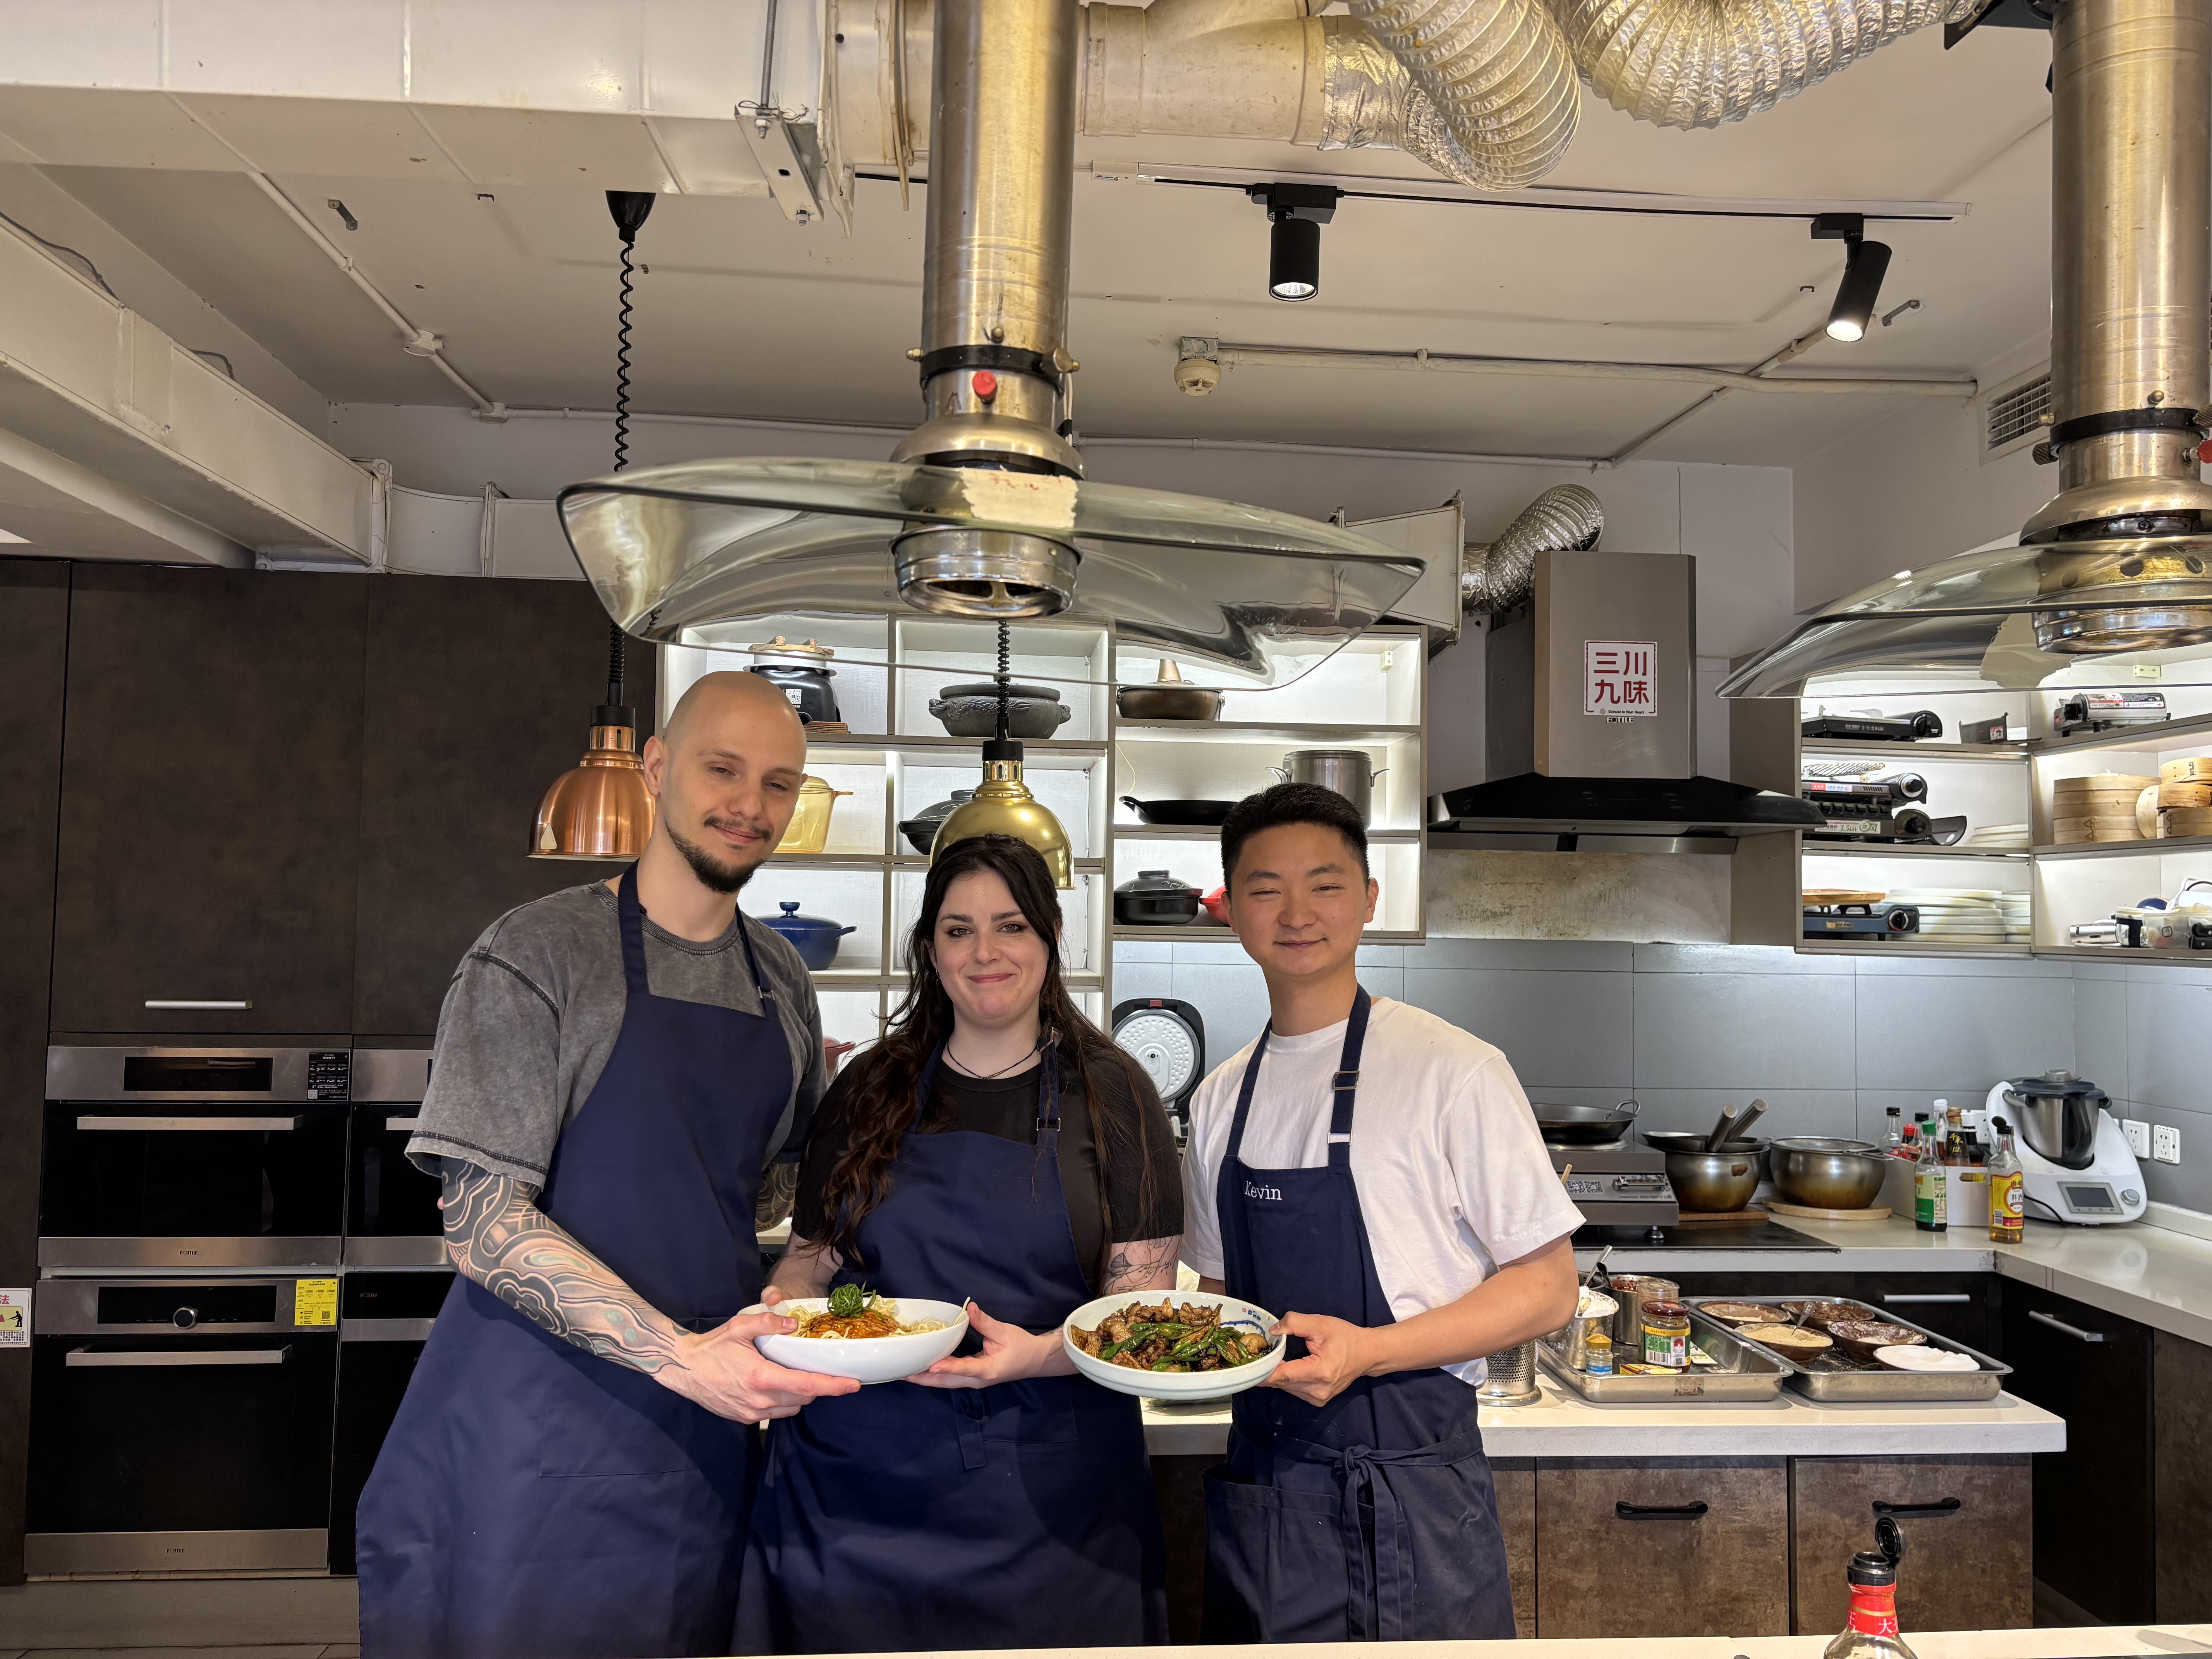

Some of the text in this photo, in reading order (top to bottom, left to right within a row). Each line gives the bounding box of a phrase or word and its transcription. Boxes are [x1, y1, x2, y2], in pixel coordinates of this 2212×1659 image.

[1594, 651, 1647, 676] 三川
[1594, 679, 1649, 704] 九味
[1244, 1180, 1282, 1200] Kevin
[0, 1295, 10, 1305] 法
